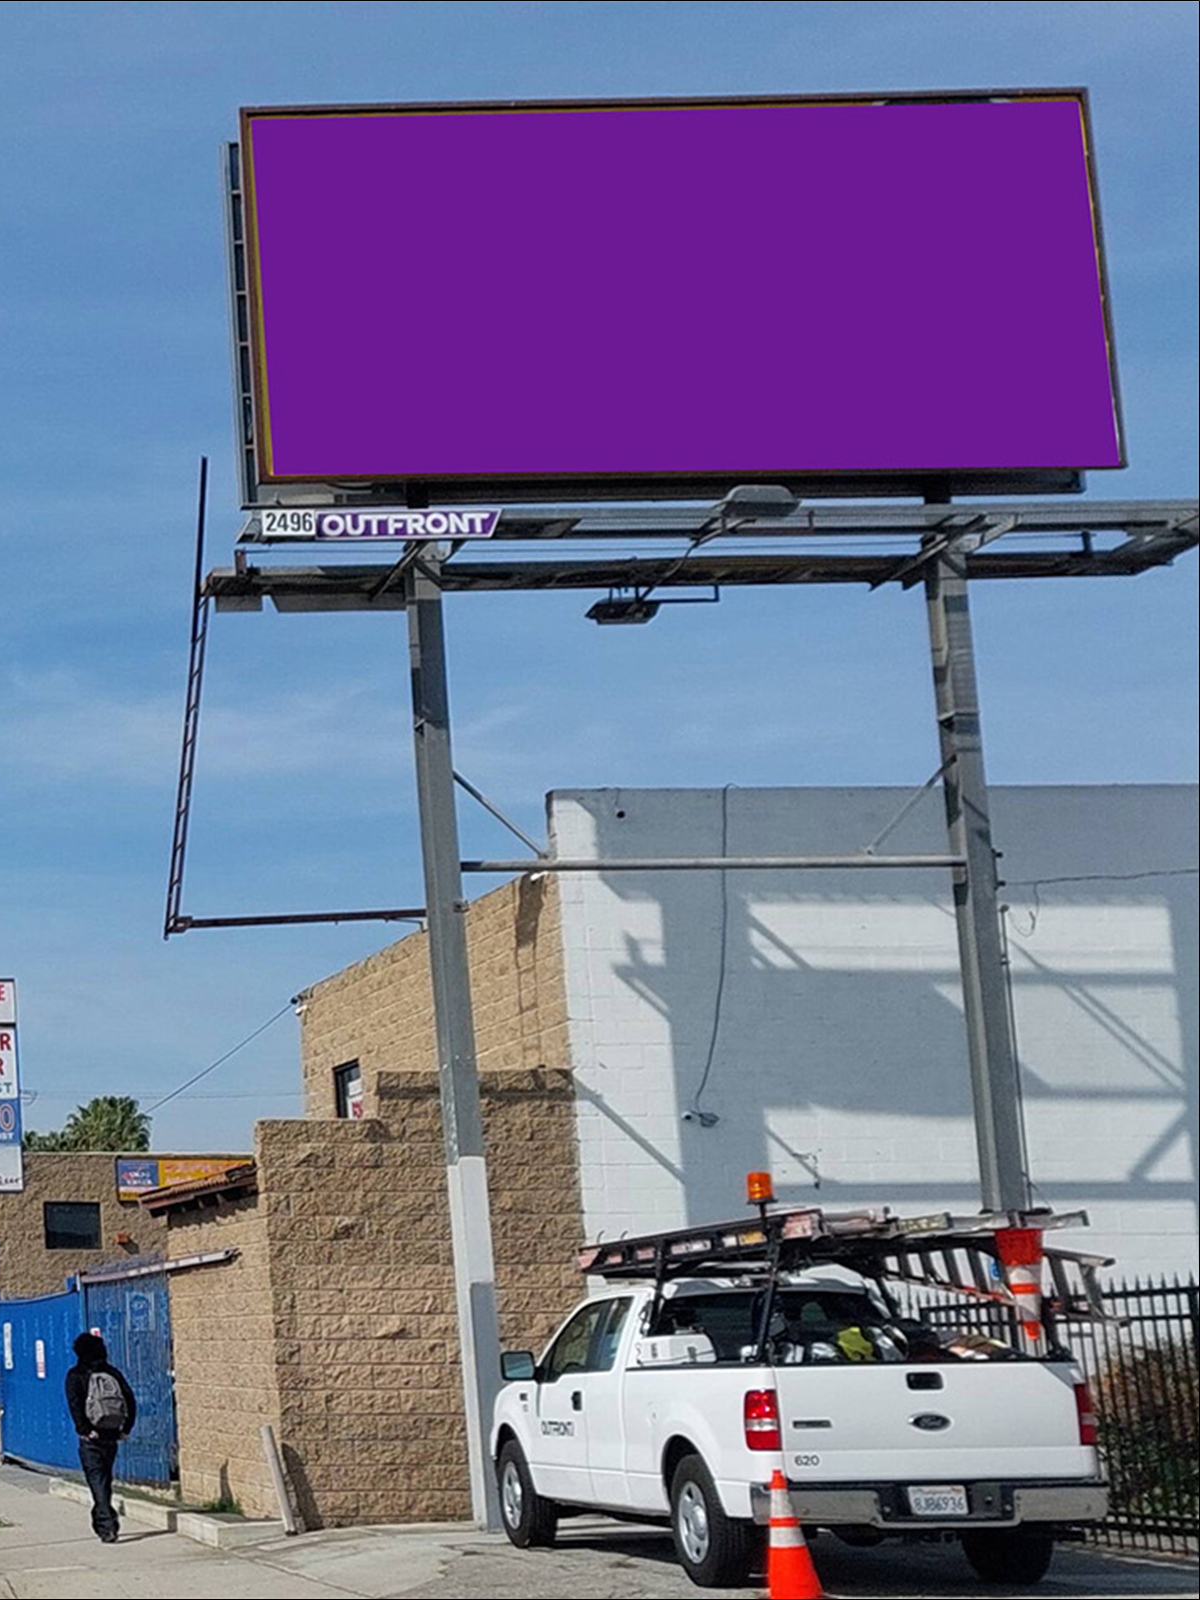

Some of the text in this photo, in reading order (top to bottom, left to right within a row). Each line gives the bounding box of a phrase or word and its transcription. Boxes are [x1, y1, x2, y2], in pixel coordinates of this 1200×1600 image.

[265, 513, 490, 536] 2496 OUTFRONT
[794, 1454, 820, 1467] 620
